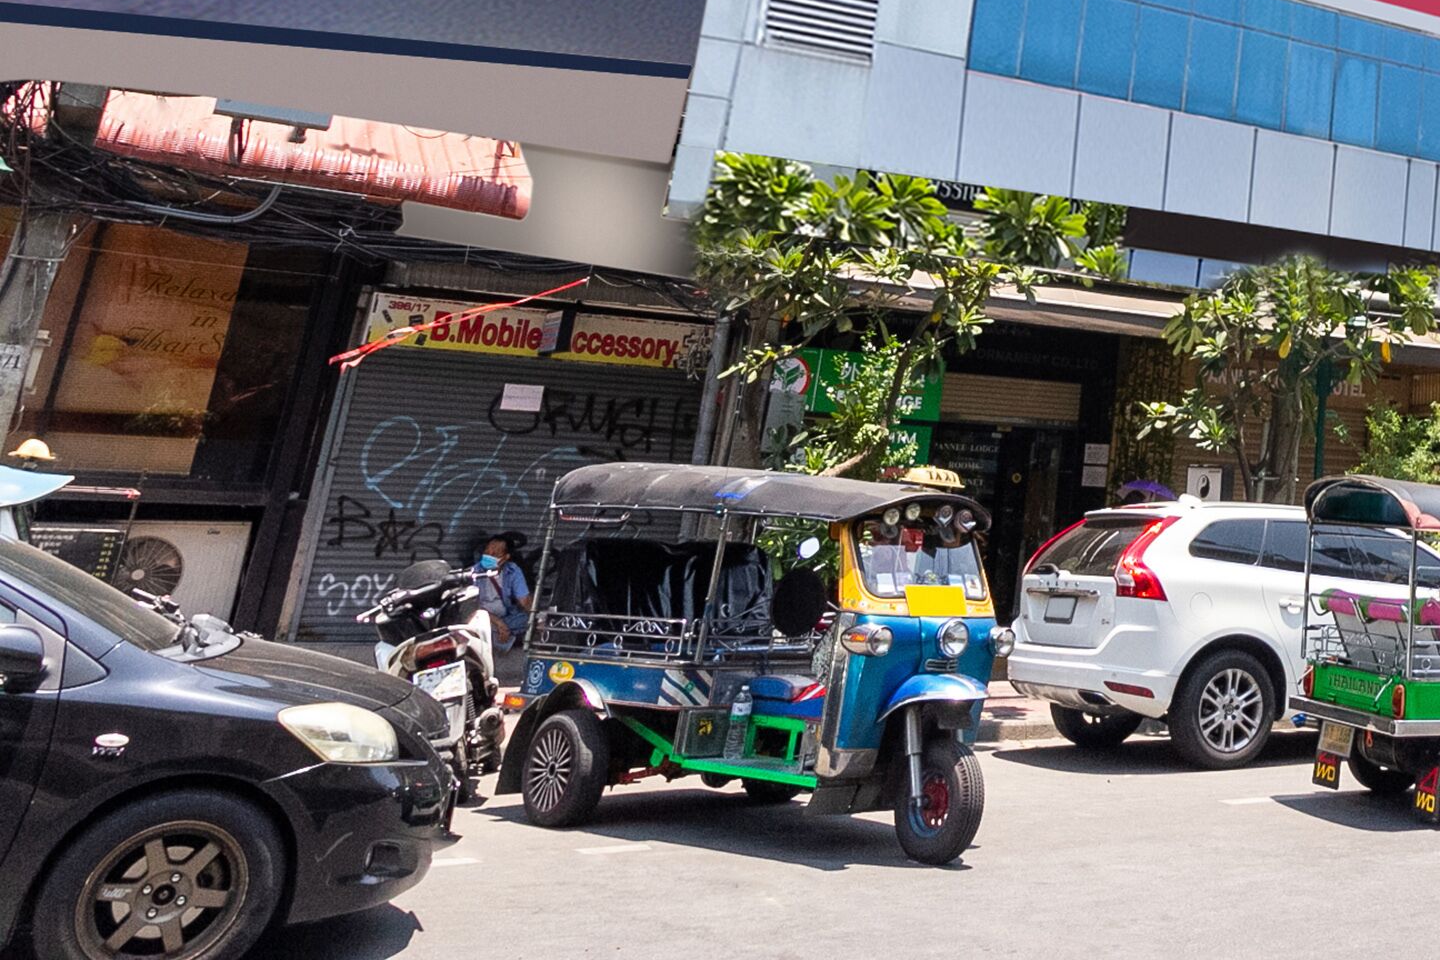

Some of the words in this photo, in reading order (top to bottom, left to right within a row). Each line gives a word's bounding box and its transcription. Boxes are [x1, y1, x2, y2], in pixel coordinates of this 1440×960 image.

[430, 310, 543, 350] B.Mobile
[571, 331, 679, 367] ccessory
[929, 471, 956, 483] TAXI
